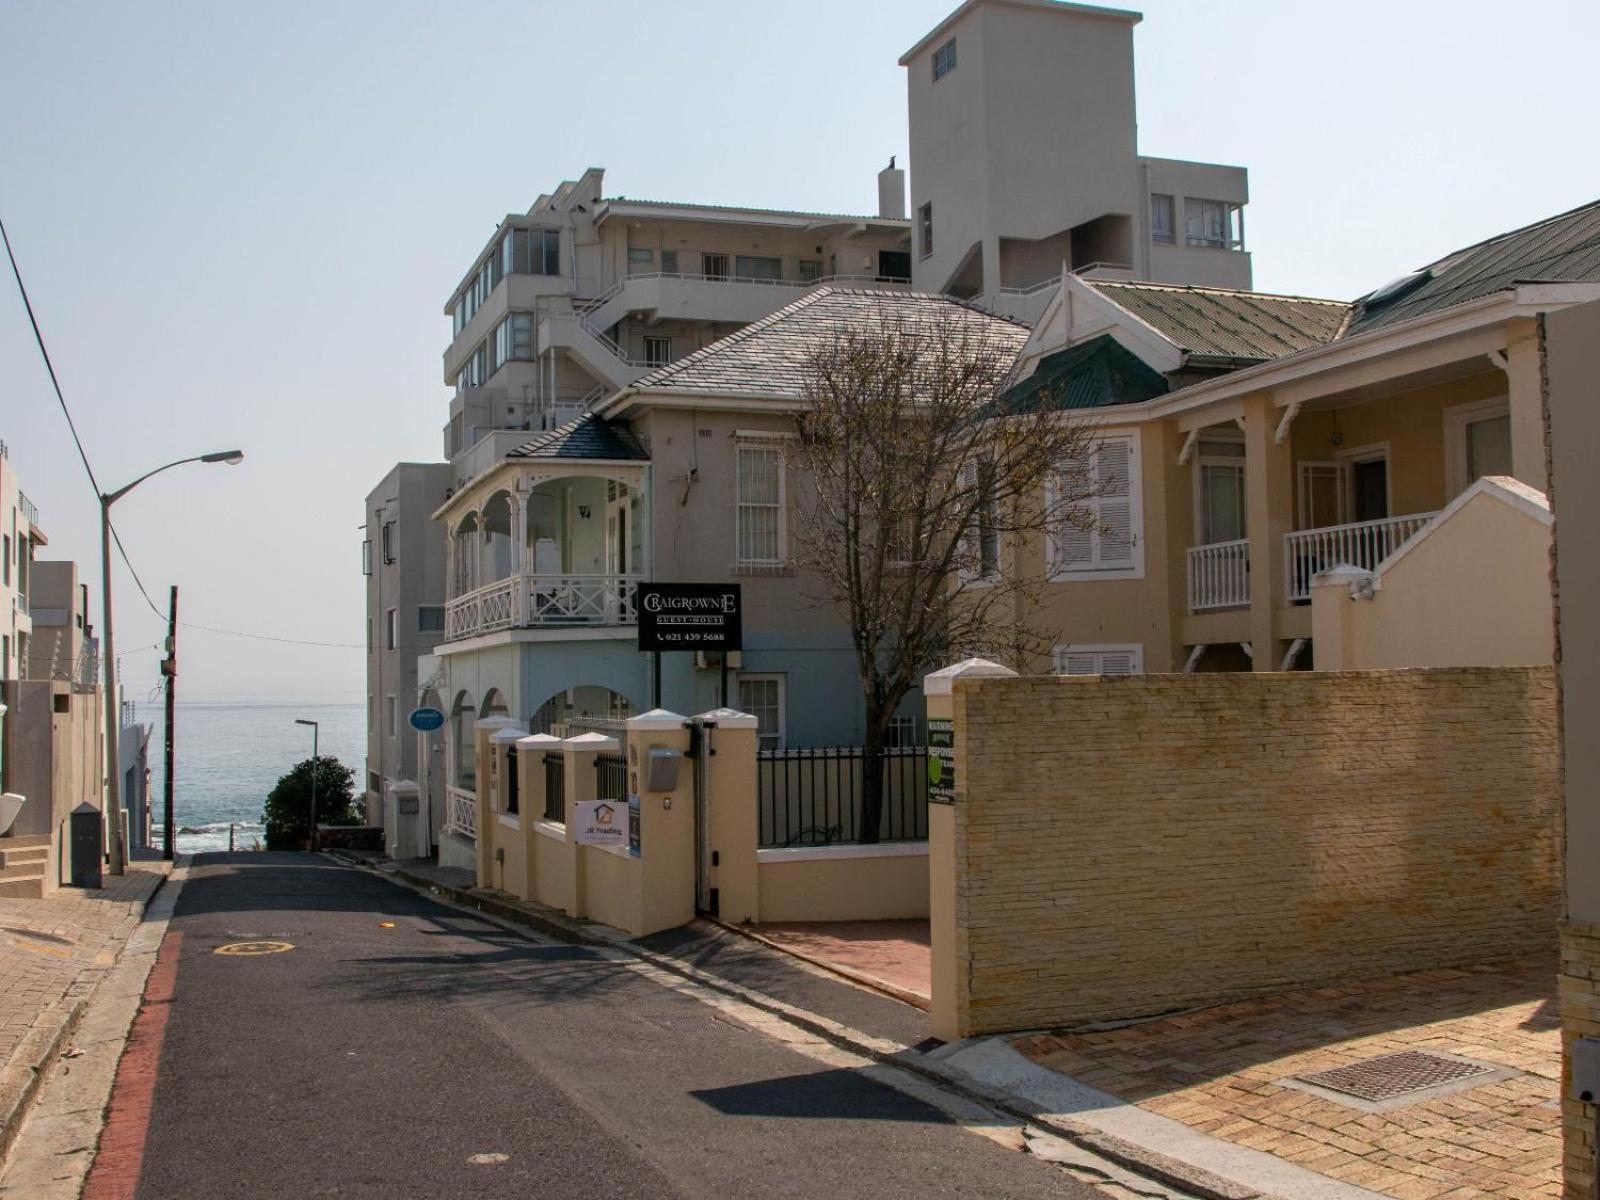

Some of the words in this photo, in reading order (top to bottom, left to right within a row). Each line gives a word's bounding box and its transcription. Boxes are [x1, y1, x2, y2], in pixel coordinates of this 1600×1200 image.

[643, 593, 736, 613] CRAIGROWNIE
[665, 633, 682, 641] 021
[684, 633, 701, 641] 439
[703, 633, 725, 641] 5688
[596, 827, 622, 835] Trading
